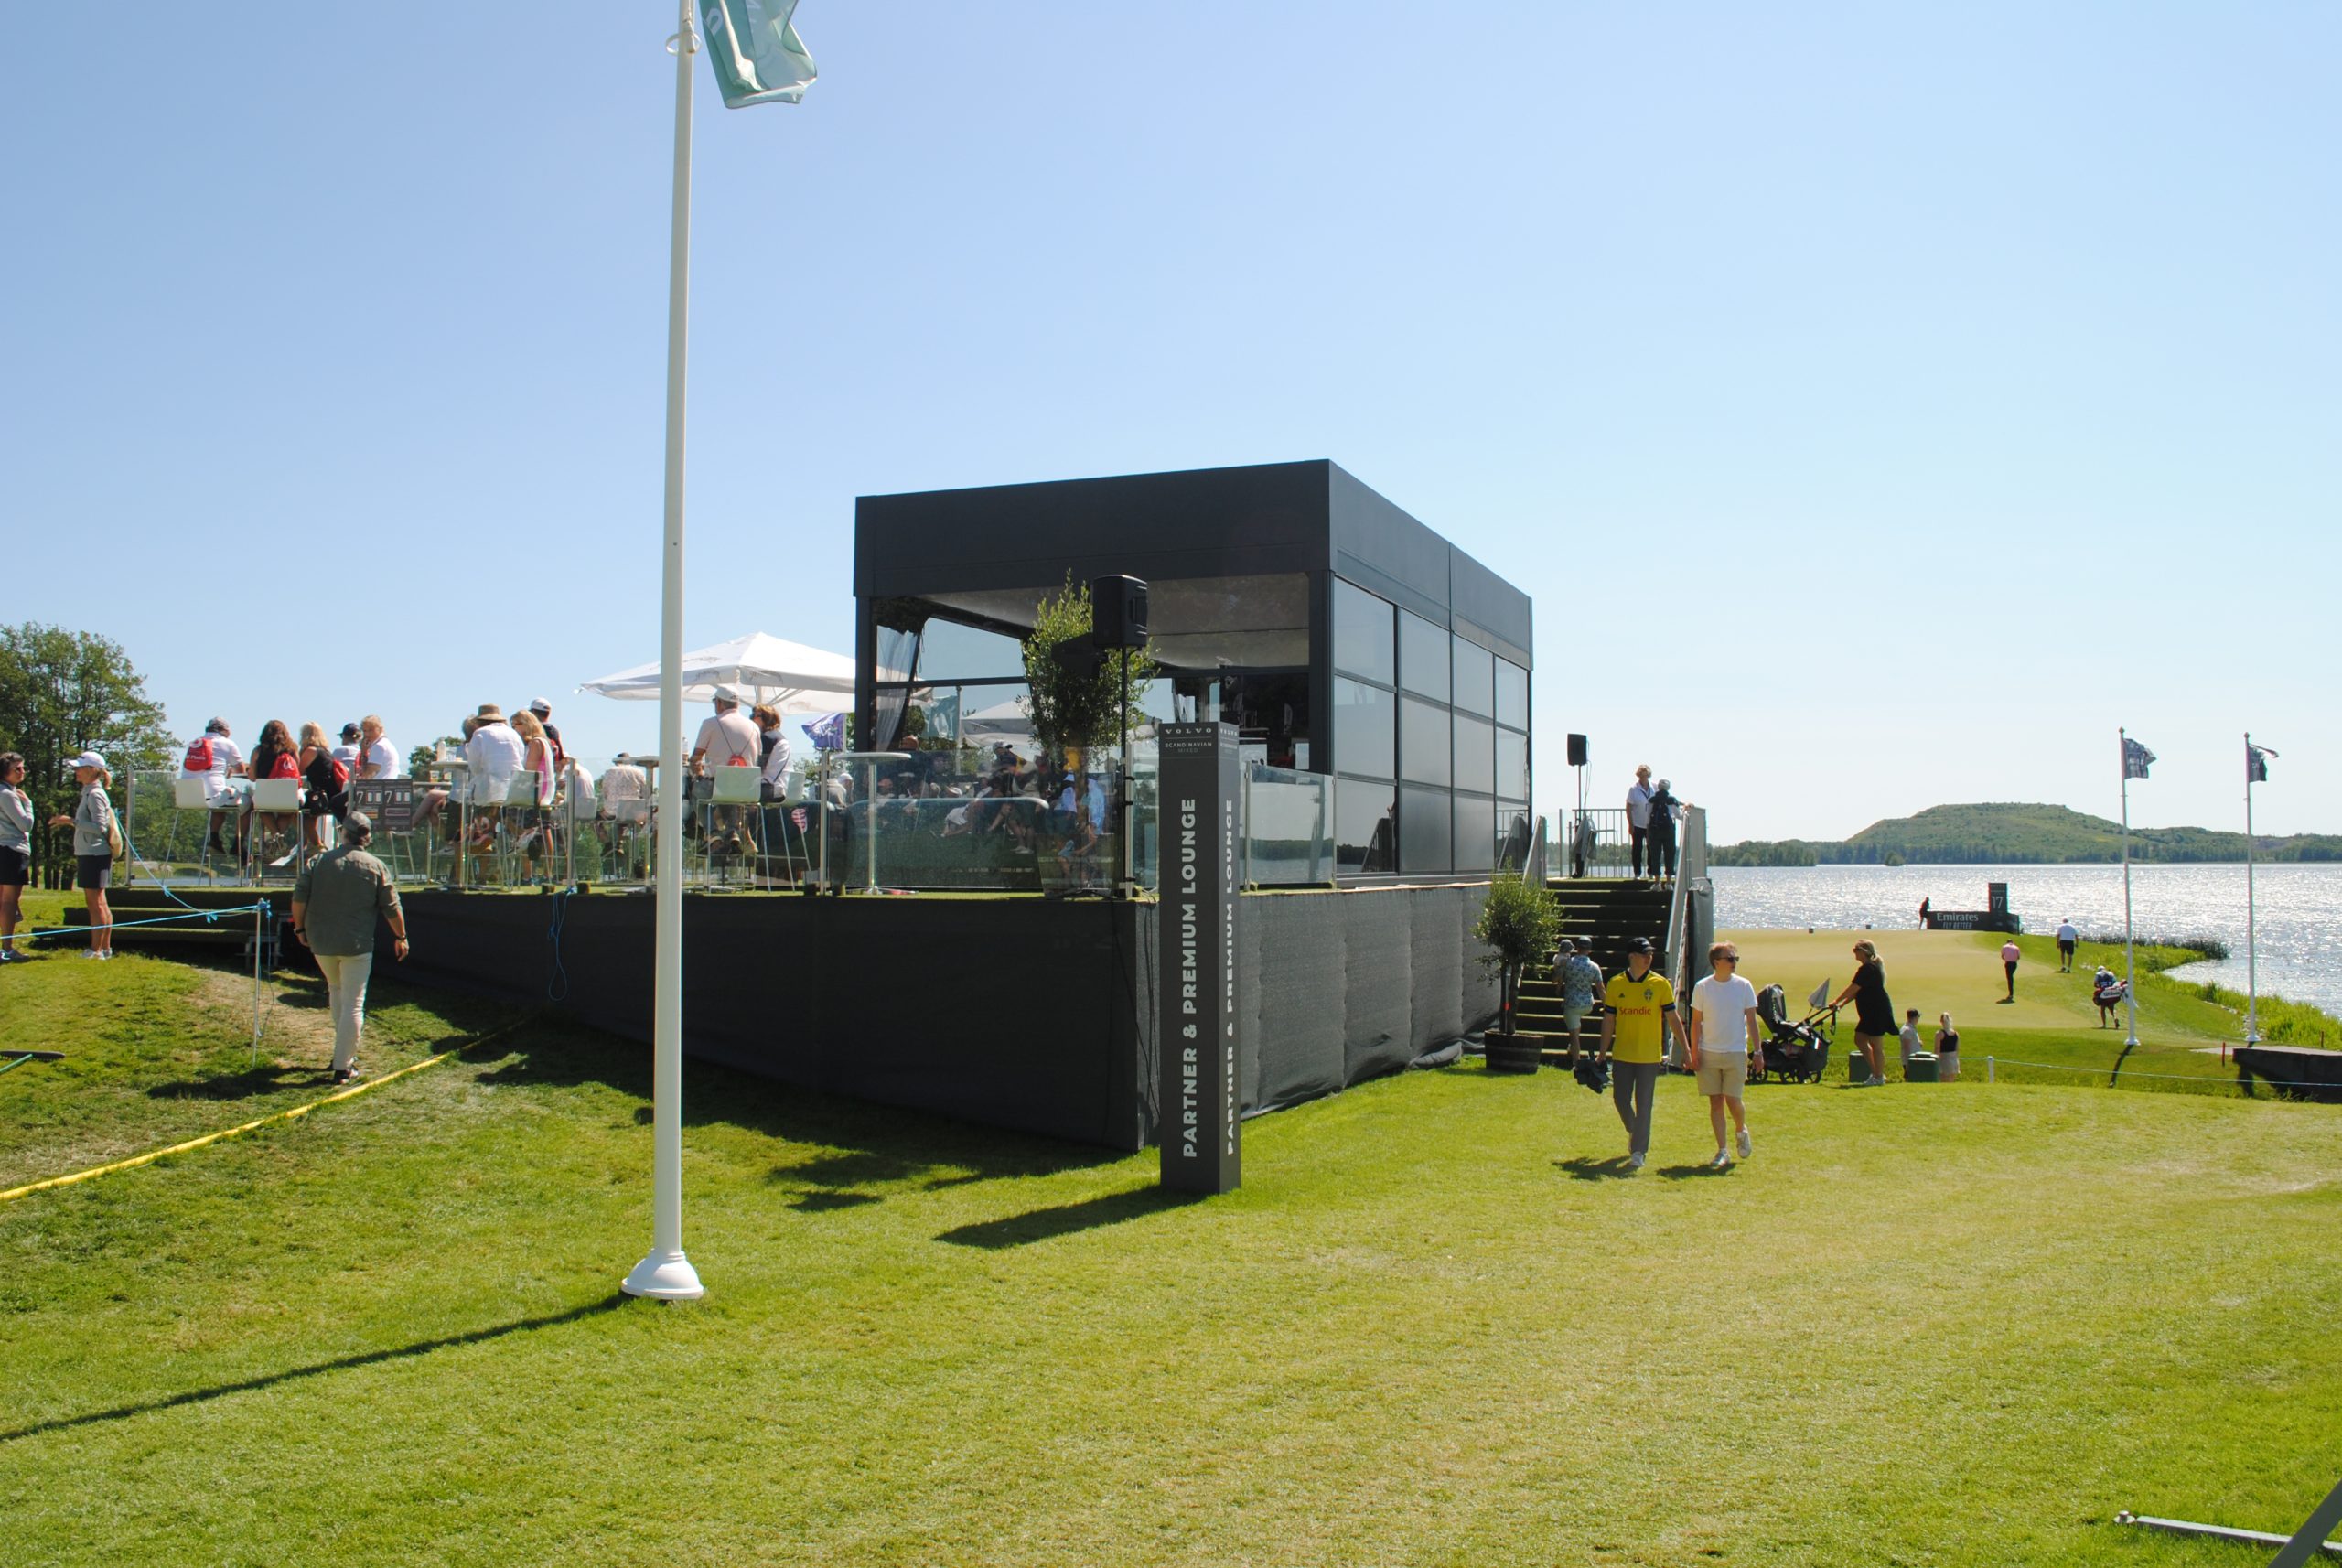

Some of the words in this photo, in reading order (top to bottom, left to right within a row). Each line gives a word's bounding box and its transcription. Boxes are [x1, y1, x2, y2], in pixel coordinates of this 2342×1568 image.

[1181, 799, 1197, 894] LOUNGE
[1991, 896, 2004, 908] 17
[1937, 912, 1979, 922] Emirates
[1182, 903, 1197, 1015] PREMIUM
[1619, 1006, 1652, 1015] Scandic
[1183, 1024, 1198, 1039] &
[1183, 1047, 1198, 1157] PARTNER
